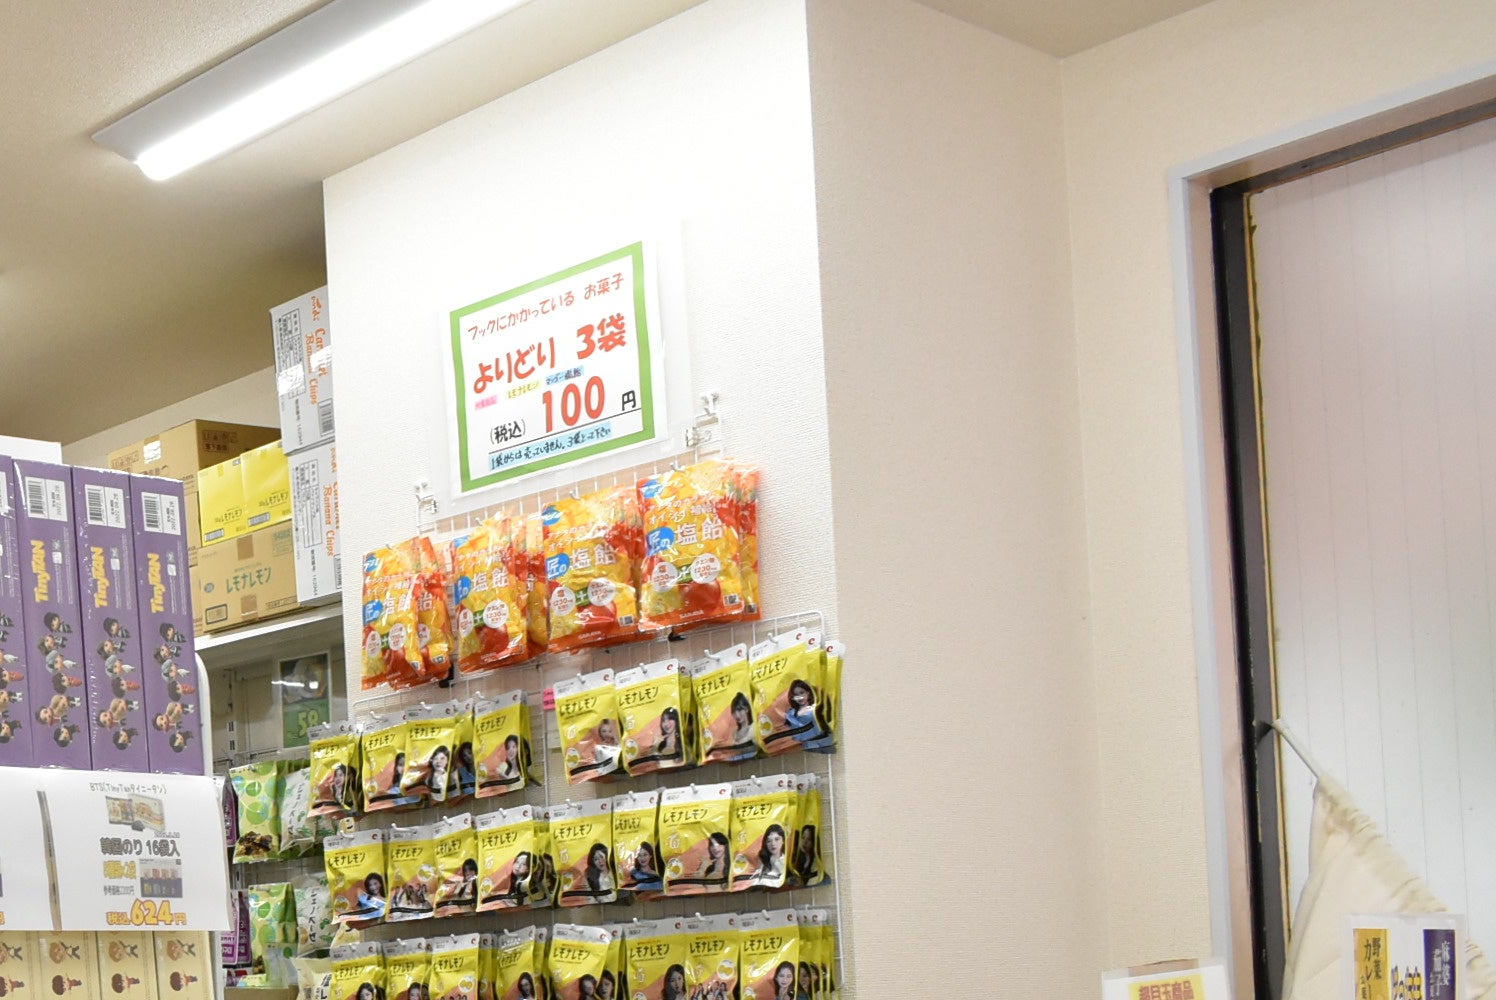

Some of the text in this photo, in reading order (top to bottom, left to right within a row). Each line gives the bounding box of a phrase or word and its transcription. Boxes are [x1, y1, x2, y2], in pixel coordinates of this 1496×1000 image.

[467, 272, 624, 341] フックにかかっている お菓子
[472, 312, 627, 394] よりどり 3袋
[541, 375, 605, 433] 100
[621, 389, 636, 412] 円
[489, 418, 526, 445] (税込)
[325, 529, 336, 558] Chips
[675, 517, 724, 546] 塩飴
[570, 542, 617, 570] 塩飴
[226, 566, 272, 595] レモナレモン
[470, 569, 510, 594] 塩飴
[751, 657, 788, 681] レモナレモン
[619, 686, 659, 708] レモナレモン
[695, 674, 732, 699] レモナレモン
[558, 696, 598, 716] レモナレモン
[663, 808, 708, 825] レモナレモン
[736, 803, 773, 820] レモナレモン
[481, 831, 518, 848] レモナレモン
[553, 823, 593, 841] レモナレモン
[100, 837, 181, 857] 韓国のり 16袋入
[327, 852, 366, 868] レモナレモン
[106, 898, 188, 926] 税込624円
[308, 887, 321, 943] ジェノベーゼ
[552, 949, 591, 962] レモナレモン
[629, 942, 671, 960] レモナレモン
[689, 939, 726, 955] レモナレモン
[743, 936, 783, 953] レモナレモン
